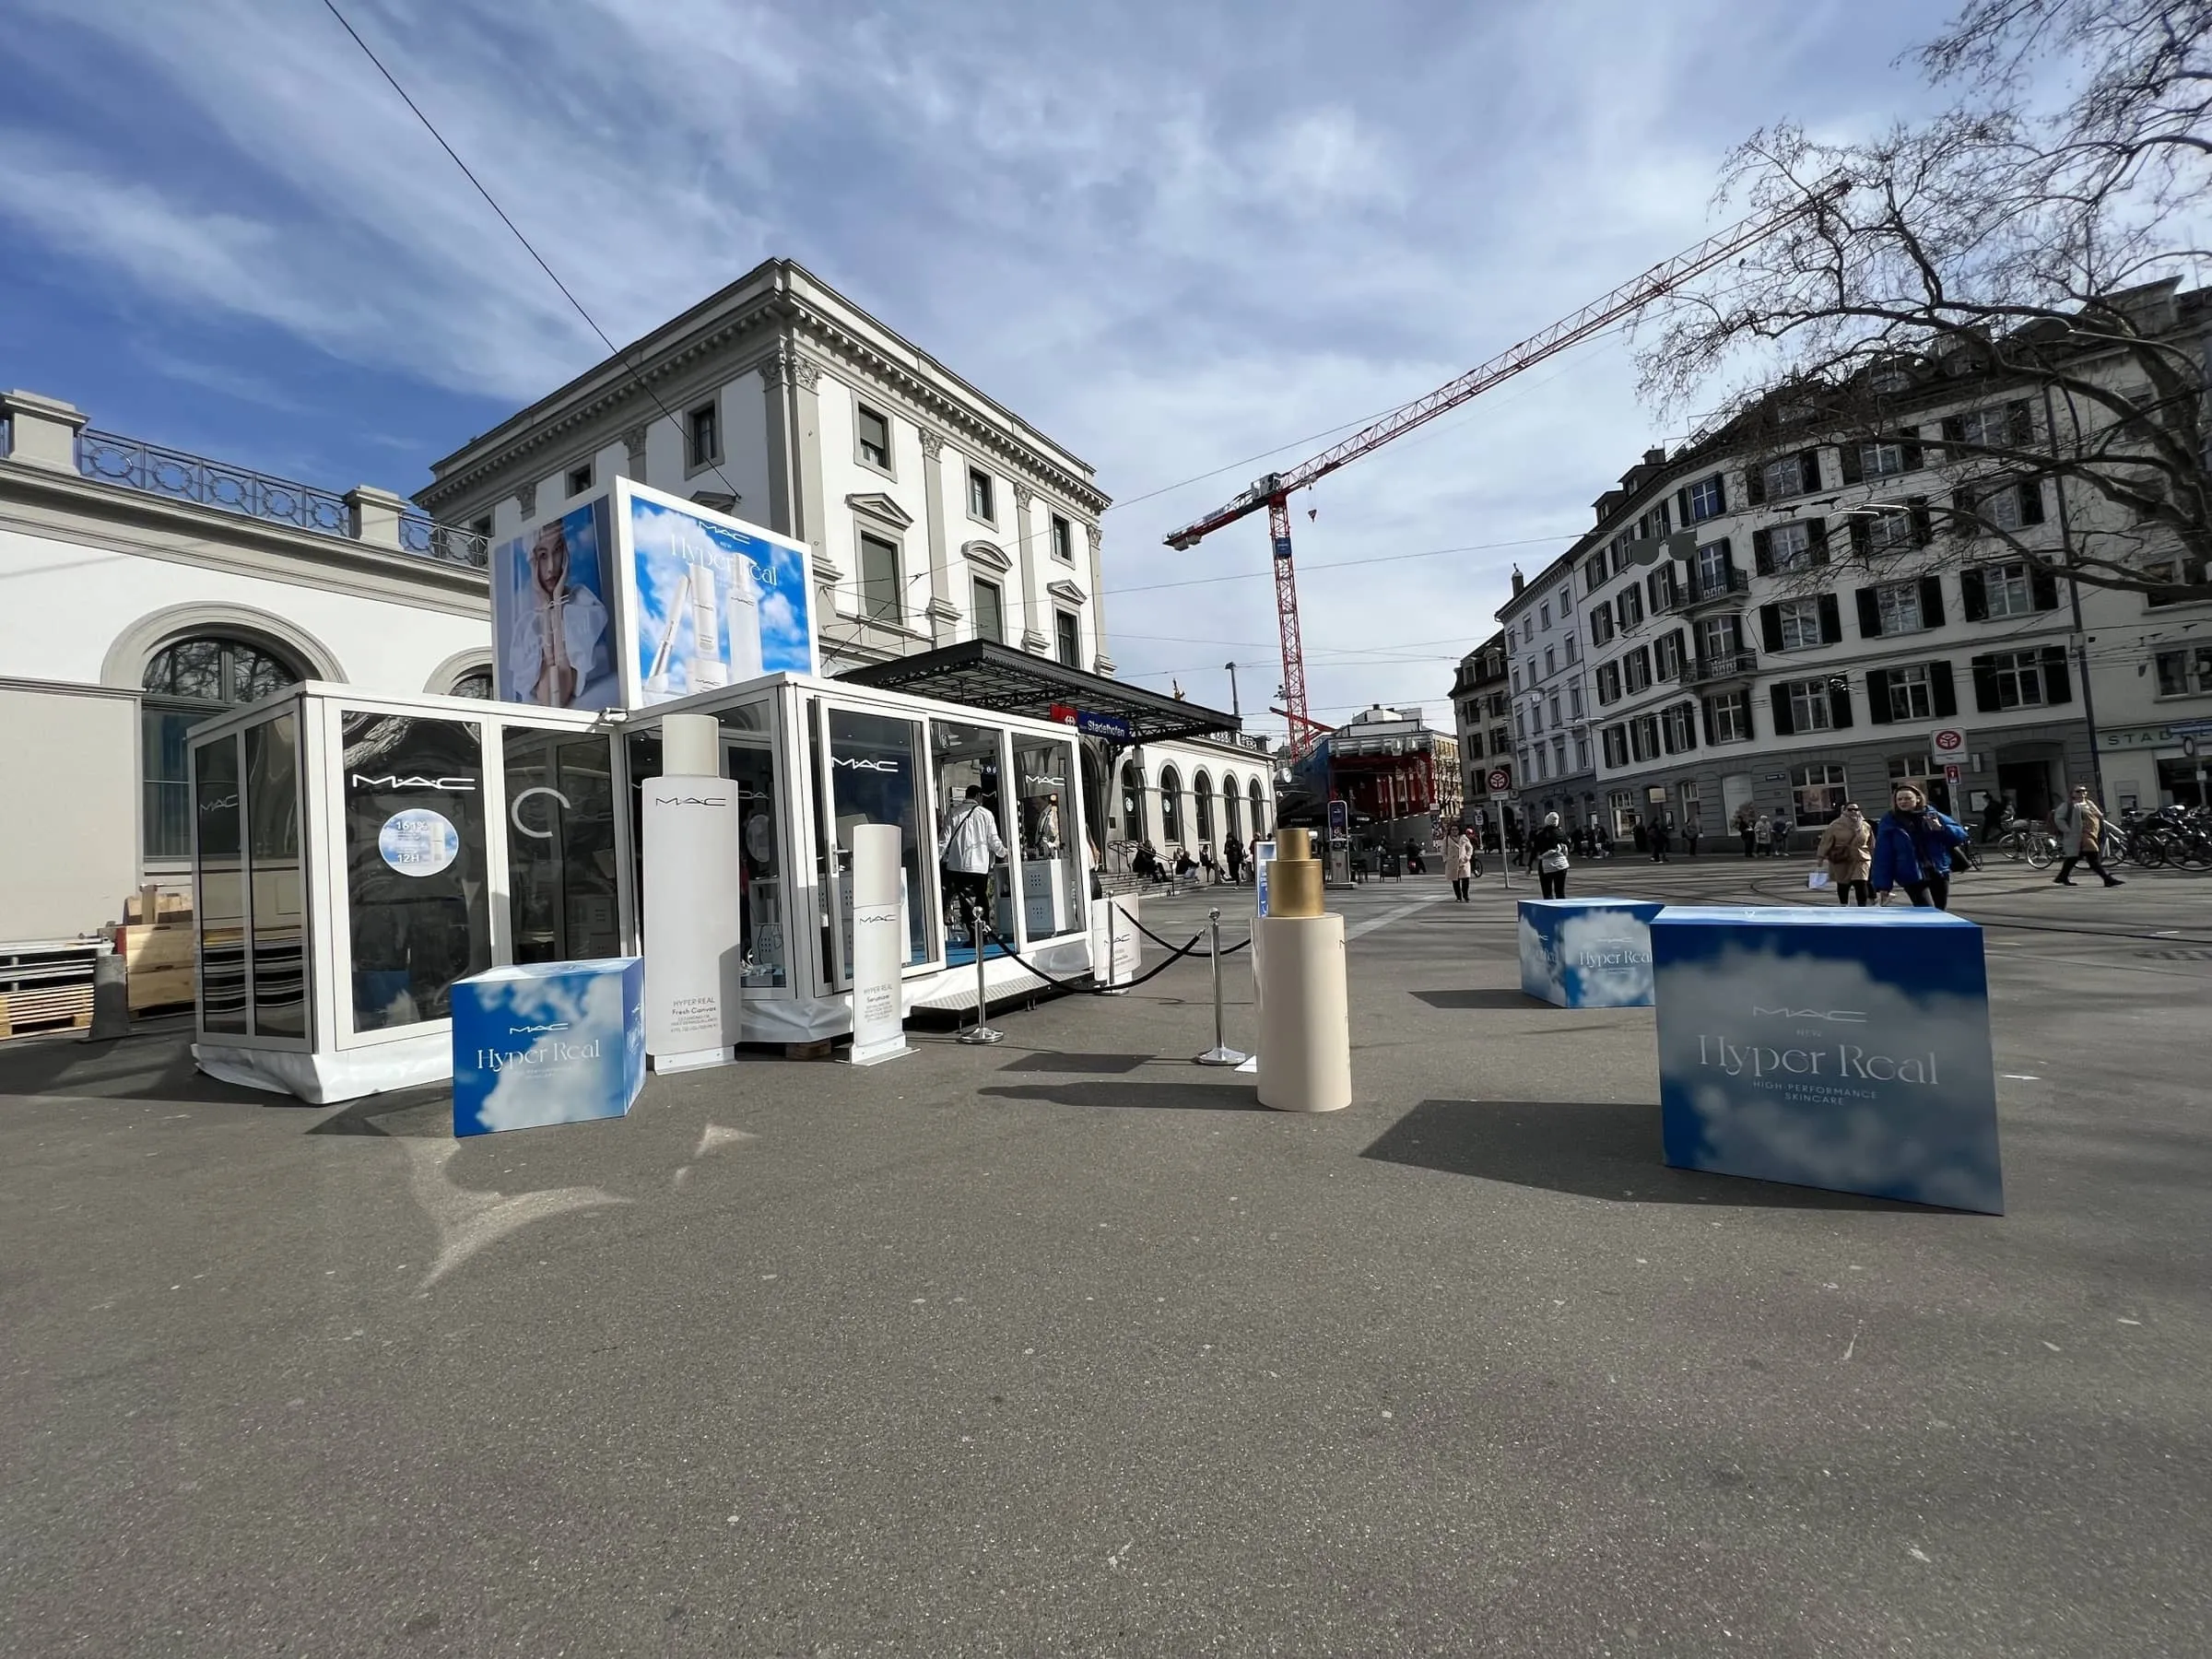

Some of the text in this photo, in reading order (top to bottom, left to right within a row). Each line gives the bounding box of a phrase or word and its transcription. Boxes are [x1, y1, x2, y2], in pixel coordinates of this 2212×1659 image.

[671, 534, 778, 586] Hyper Real
[1088, 720, 1125, 737] Stadelhofen
[353, 774, 476, 790] MAC
[1025, 774, 1065, 786] MAC
[655, 797, 726, 806] MAC
[397, 853, 420, 864] 12H
[860, 914, 897, 925] MAC
[1580, 950, 1653, 967] Hyper Real
[673, 996, 715, 1006] HYPER REAL
[1753, 1006, 1867, 1023] MAC
[510, 1022, 569, 1035] MAC
[1796, 1028, 1823, 1038] NEW
[477, 1039, 601, 1073] Hyper Real
[1697, 1034, 1938, 1085] Hyper Real
[1784, 1090, 1845, 1106] SKINCARE
